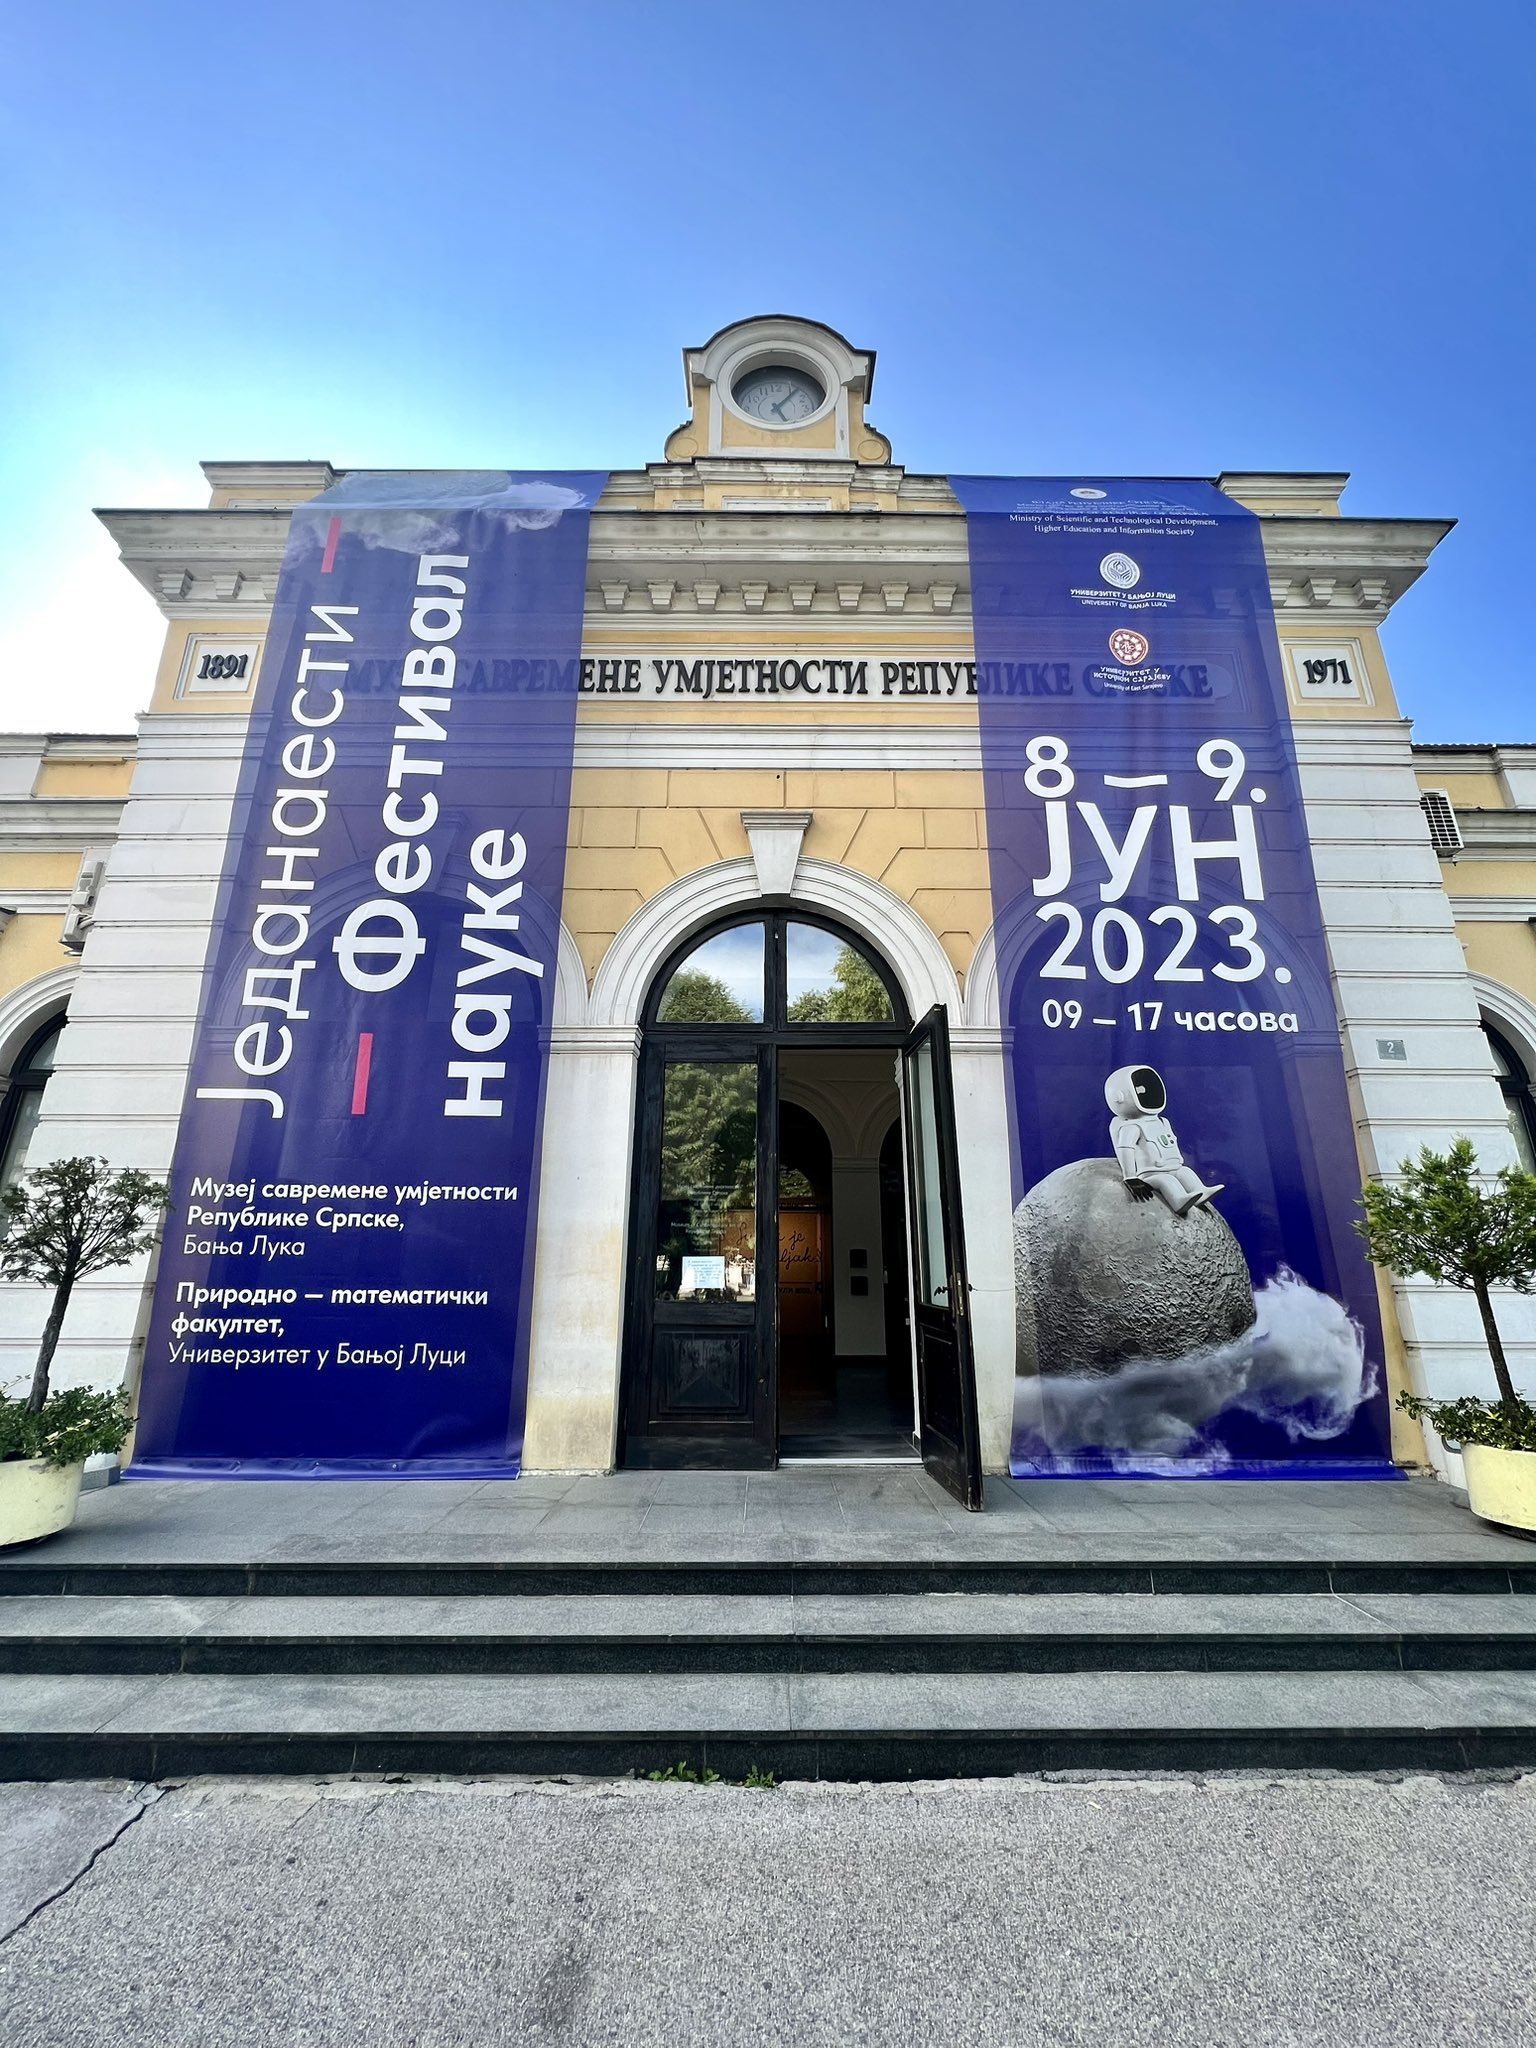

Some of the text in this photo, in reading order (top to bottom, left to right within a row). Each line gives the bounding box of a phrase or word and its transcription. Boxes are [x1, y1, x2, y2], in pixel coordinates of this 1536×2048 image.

[1057, 515, 1092, 523] Scientific
[1110, 517, 1163, 525] Technological
[1165, 518, 1219, 526] Development,
[1119, 527, 1164, 535] Information
[1166, 528, 1195, 536] Society
[1071, 589, 1120, 597] УНИВЕРЗИТЕТ
[197, 653, 248, 680] 1891
[652, 659, 868, 699] УМЈЕТНОСТИ
[880, 661, 1073, 696] РЕПУБЛИКЕ
[1303, 658, 1353, 684] 1971
[331, 554, 470, 992] Фестивал
[1024, 736, 1074, 798] 8
[1196, 739, 1266, 802] 9.
[196, 605, 360, 1119] Једанаести
[1036, 902, 1292, 984] 2023.
[444, 828, 545, 1117] науке
[1042, 999, 1082, 1028] 09
[1128, 1002, 1162, 1031] 17
[1174, 1012, 1299, 1032] часова
[1387, 1041, 1395, 1054] 2
[191, 1177, 517, 1205] Музеј савремене умјетности
[187, 1206, 405, 1232] Републике Српске,
[184, 1235, 305, 1261] Бања Лука
[176, 1282, 297, 1309] Природно
[171, 1312, 284, 1338] факултет,
[168, 1342, 465, 1370] Универзитет у Бањој Луци
